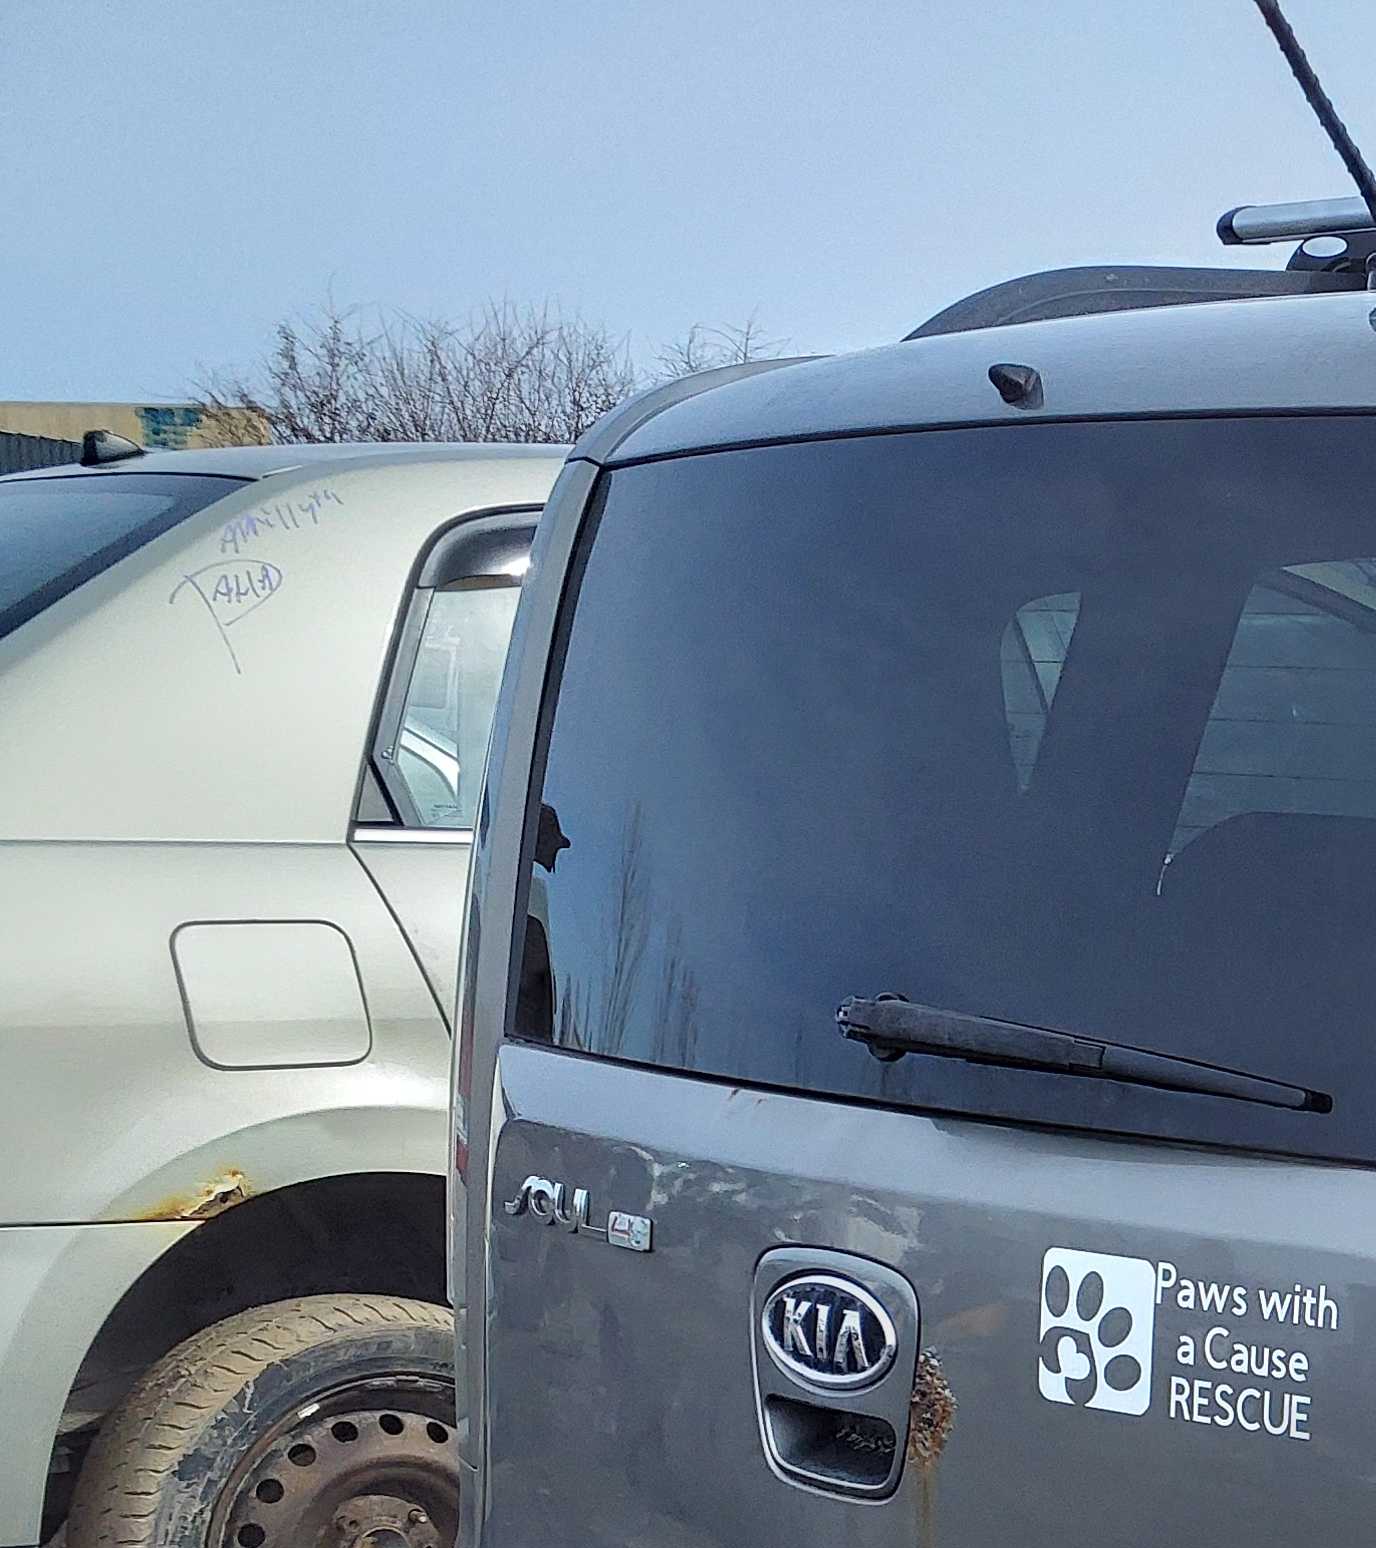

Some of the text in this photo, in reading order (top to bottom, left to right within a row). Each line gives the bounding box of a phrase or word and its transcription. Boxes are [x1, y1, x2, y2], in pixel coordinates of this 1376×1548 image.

[503, 1175, 608, 1235] SOUL
[1155, 1260, 1339, 1331] Paws with
[782, 1296, 870, 1372] KIA
[1176, 1326, 1310, 1382] a Cause
[1169, 1375, 1312, 1441] RESCUE
